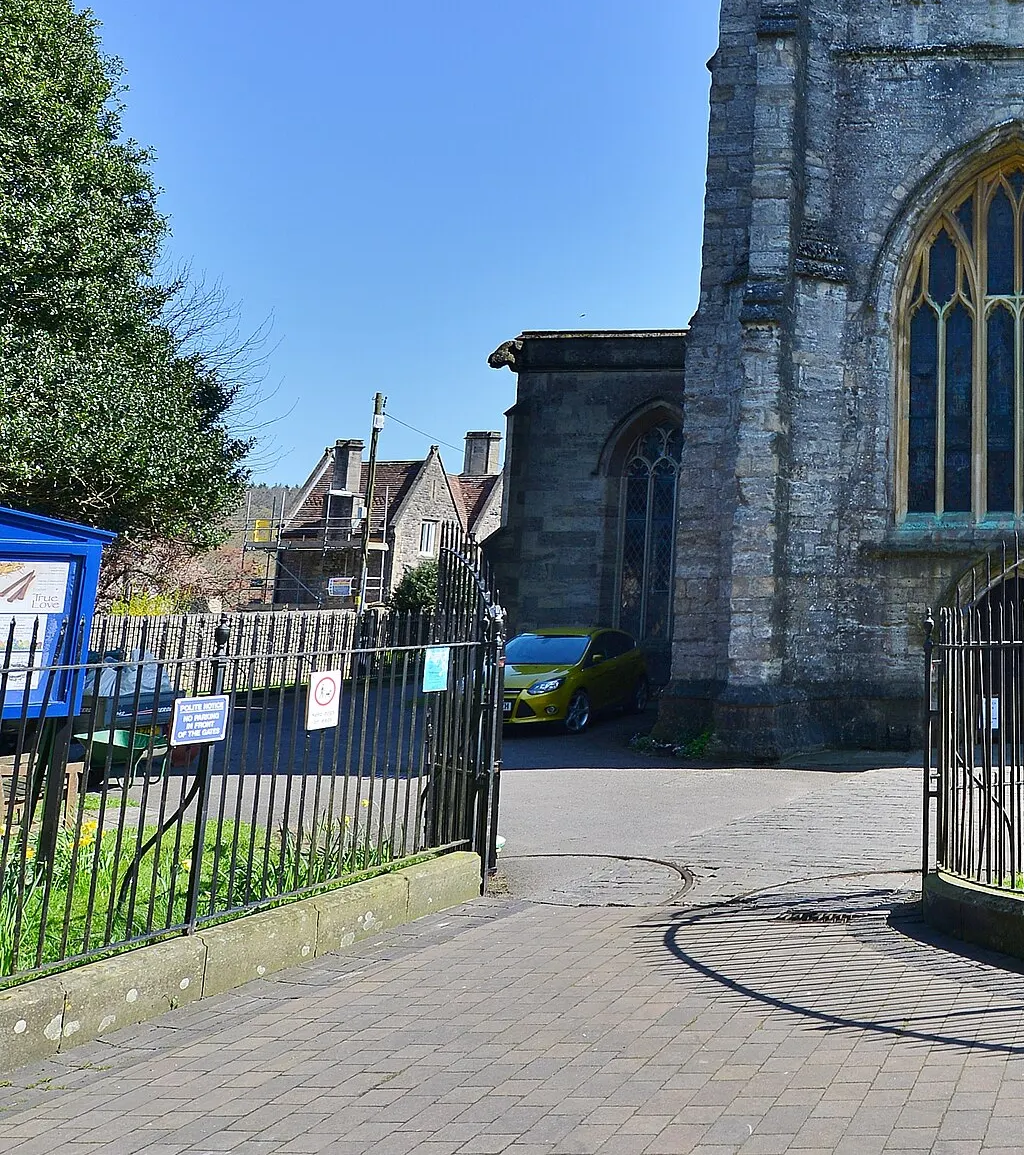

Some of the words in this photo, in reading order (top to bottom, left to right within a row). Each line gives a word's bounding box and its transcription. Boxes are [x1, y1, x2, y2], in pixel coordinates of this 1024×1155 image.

[32, 593, 59, 602] True
[31, 600, 60, 609] Love
[180, 704, 203, 712] POLITE
[194, 713, 219, 721] PARKING
